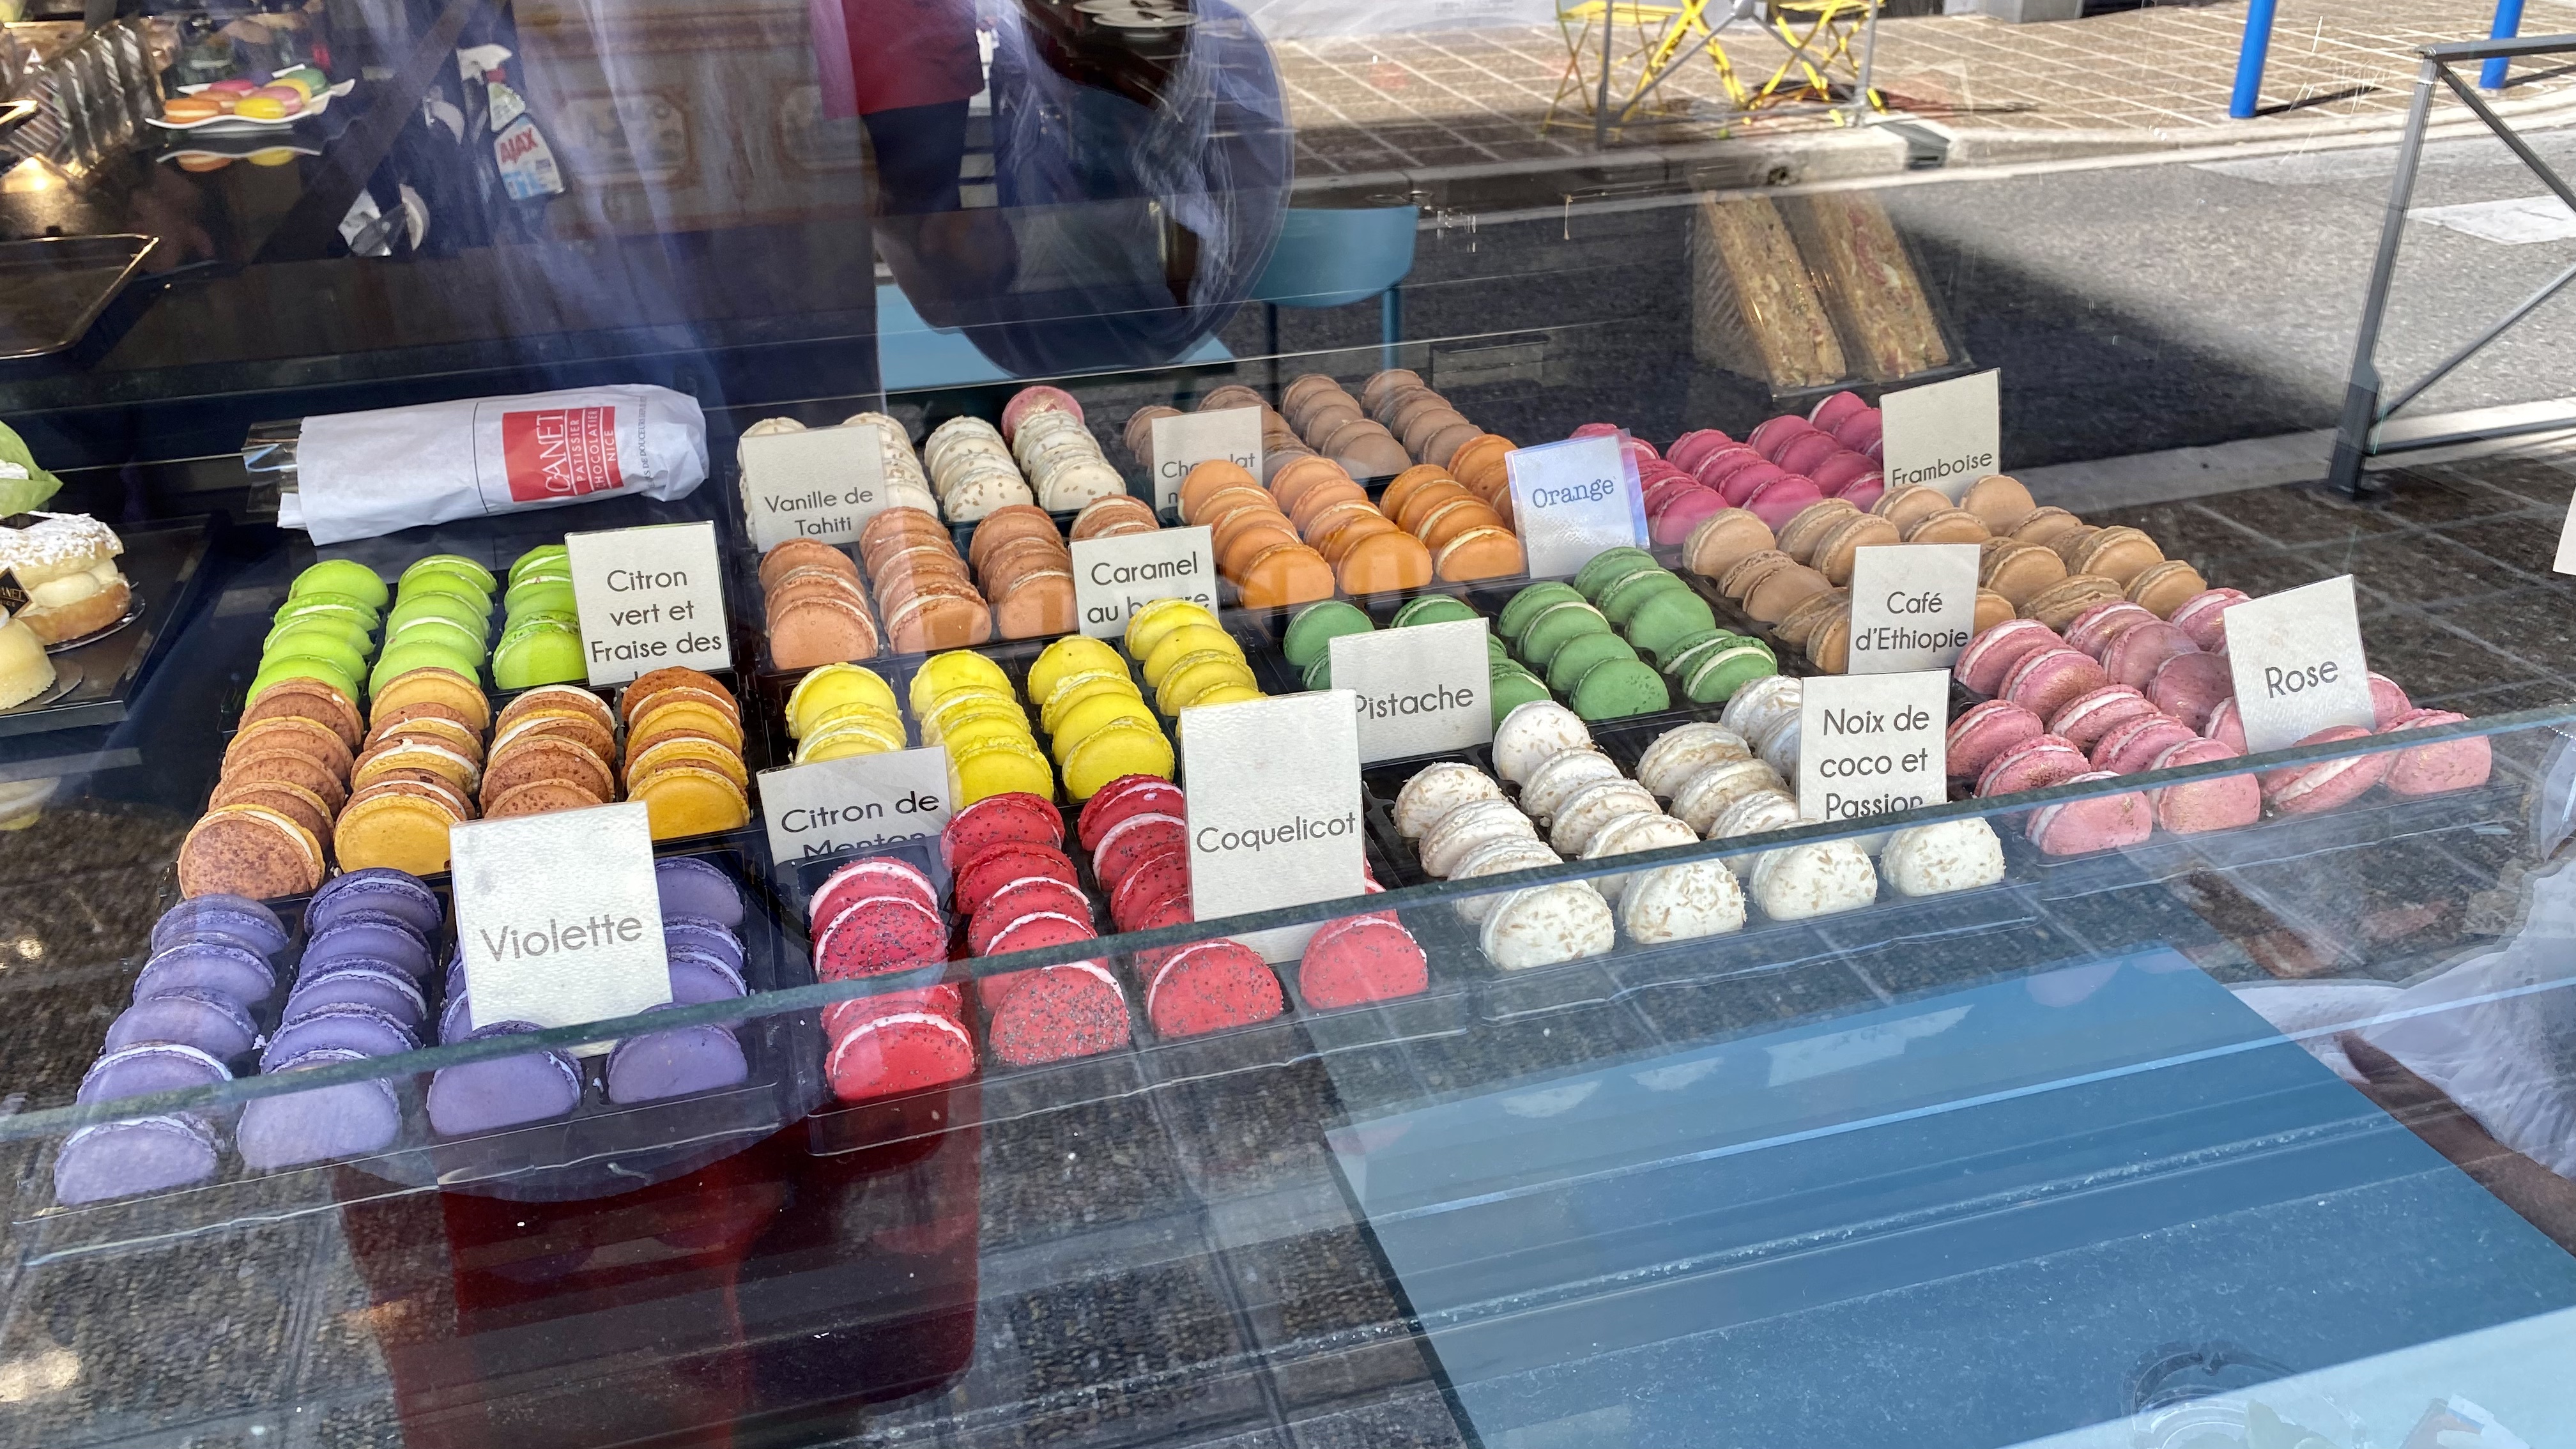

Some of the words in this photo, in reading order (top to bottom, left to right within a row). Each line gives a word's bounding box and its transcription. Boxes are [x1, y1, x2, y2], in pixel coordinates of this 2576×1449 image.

[536, 414, 571, 493] CANET
[570, 418, 586, 482] PATISSIER
[587, 410, 606, 488] CHOCOLATIER
[604, 429, 617, 462] NICE
[1162, 453, 1255, 478] Chlat
[1892, 452, 1993, 487] Framboise
[765, 491, 838, 513] Vanille
[844, 487, 873, 504] de
[1532, 479, 1614, 509] Orange
[795, 517, 852, 536] Tahiti
[607, 569, 688, 592] Citron
[1091, 551, 1198, 586] Caramel
[610, 603, 660, 627] vert
[668, 600, 694, 621] et
[1087, 605, 1119, 624] au
[1887, 591, 1943, 614] Café
[590, 641, 668, 663] Fraise
[676, 631, 723, 654] des
[1855, 626, 1968, 653] d'Ethiopie
[2264, 661, 2339, 699] Rose
[1823, 708, 1885, 736] Noix
[1893, 704, 1930, 732] de
[1820, 755, 1892, 778] coco
[1901, 747, 1928, 772] et
[781, 802, 884, 833] Citron
[895, 790, 940, 814] de
[1197, 812, 1356, 853] Coquelicot
[479, 914, 643, 962] Violette
